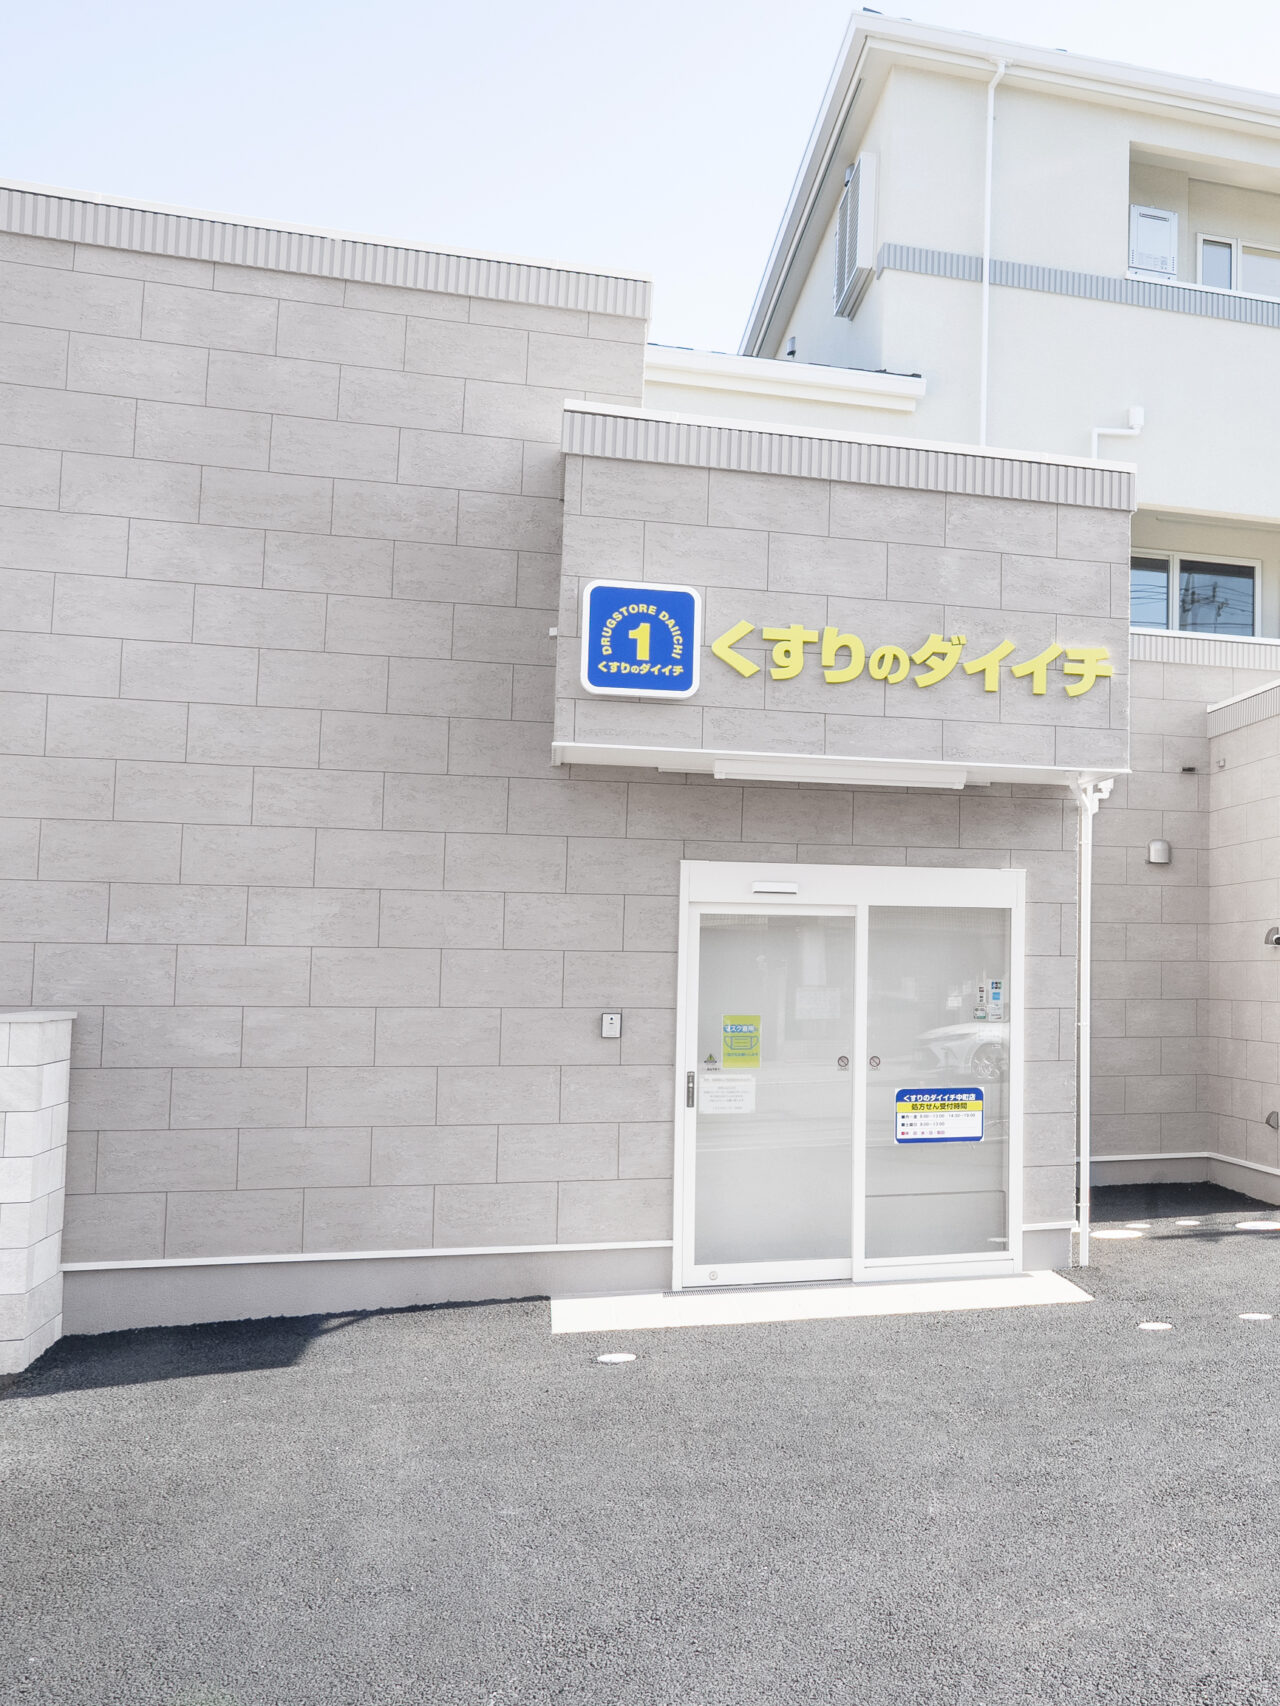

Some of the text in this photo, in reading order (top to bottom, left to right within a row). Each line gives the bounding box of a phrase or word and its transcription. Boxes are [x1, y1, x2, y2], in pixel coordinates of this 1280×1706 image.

[601, 604, 683, 659] DRUGSTORE DAIICHI
[628, 622, 650, 661] 1
[597, 661, 684, 676] くすりのダイイチ
[711, 619, 1114, 697] くすりのダイイチ
